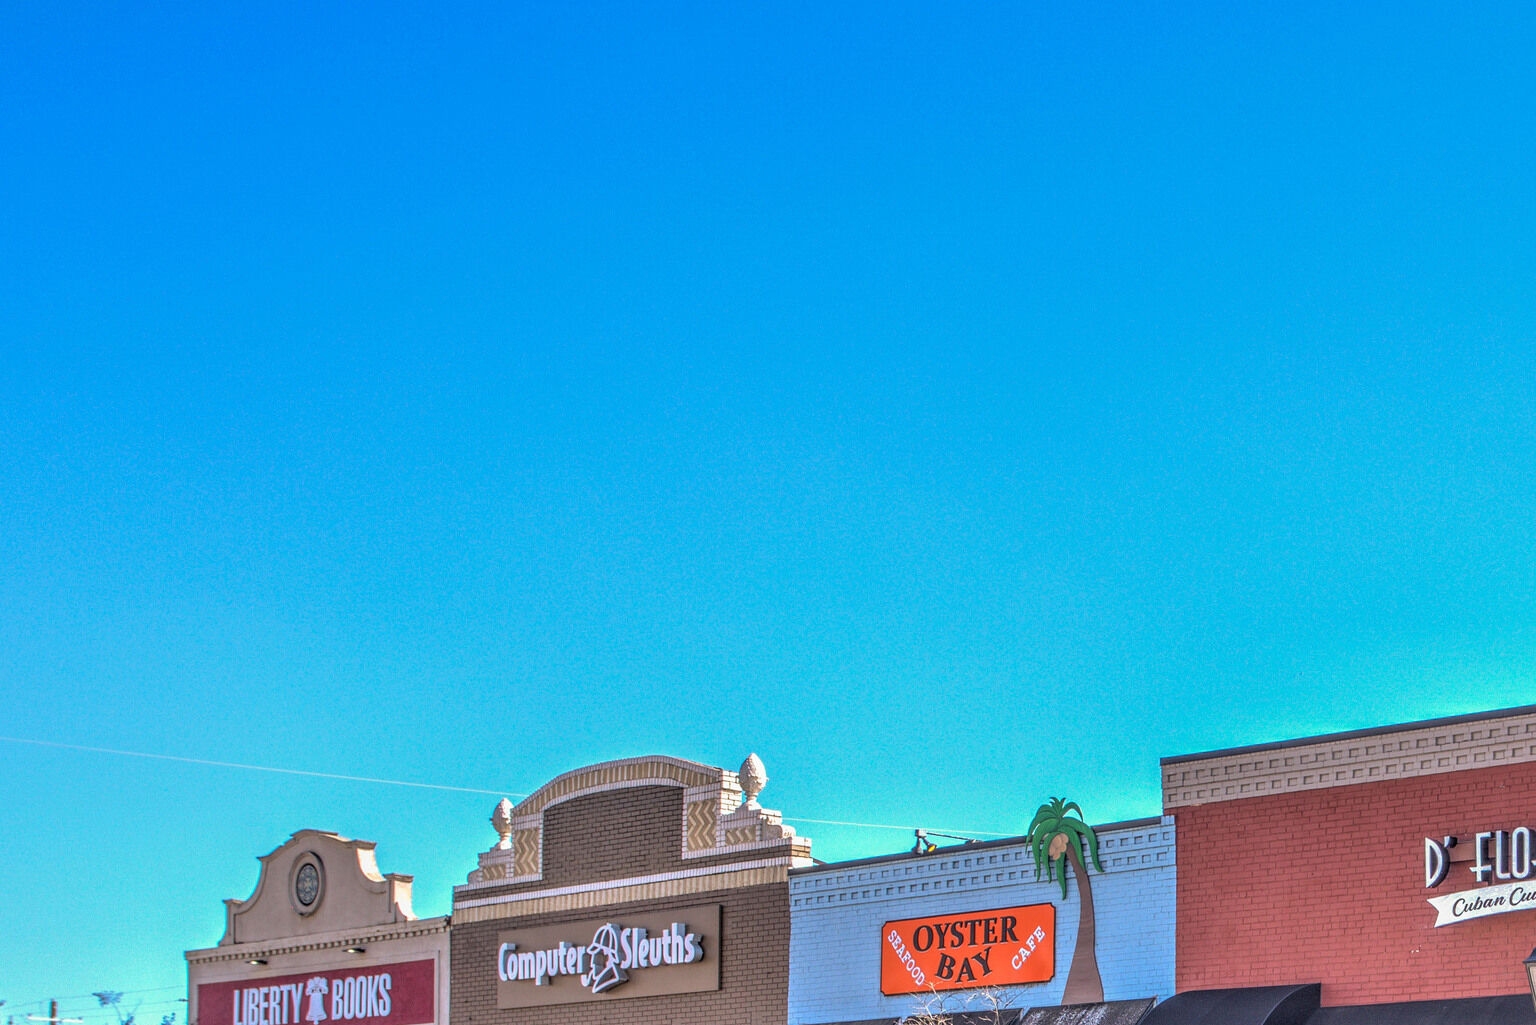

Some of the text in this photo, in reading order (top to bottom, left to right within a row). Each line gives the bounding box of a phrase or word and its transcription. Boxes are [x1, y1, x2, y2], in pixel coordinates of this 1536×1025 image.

[1425, 836, 1451, 889] D'
[1452, 898, 1506, 917] Cuban
[498, 922, 698, 986] Computer Sleuths
[888, 929, 926, 986] SEAFOOD
[912, 915, 1019, 953] OYSTER
[1010, 925, 1047, 971] CAFE
[934, 947, 993, 984] BAY
[331, 973, 392, 1021] BOOKS
